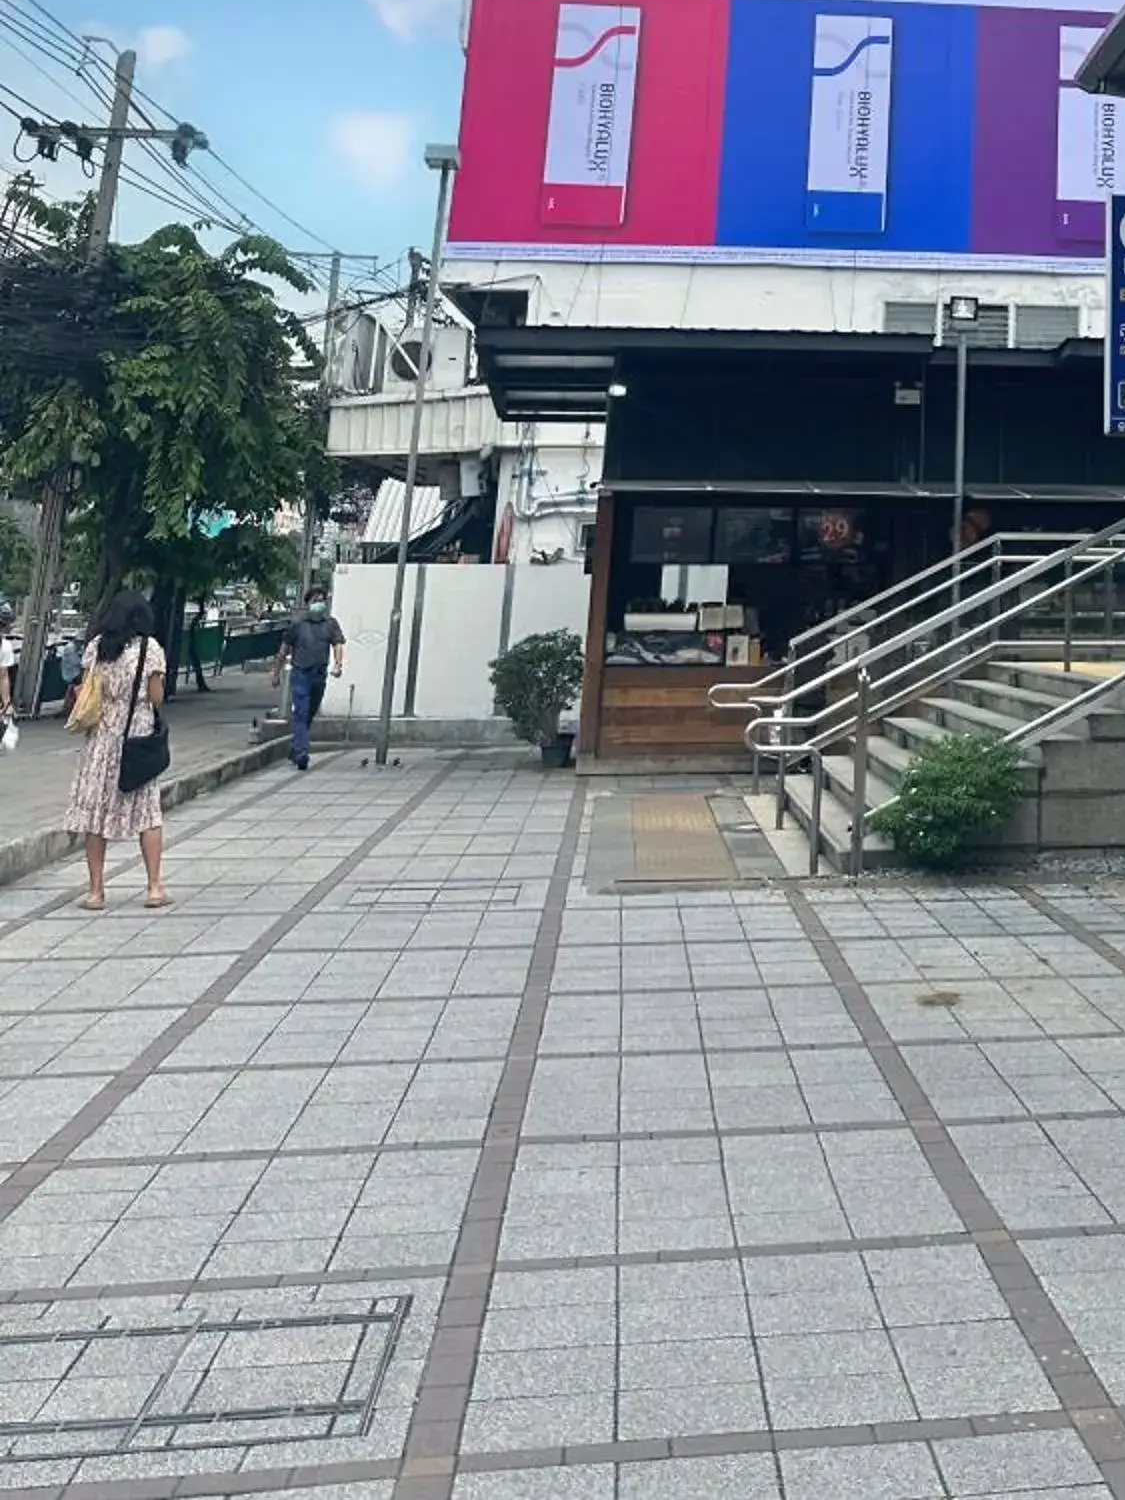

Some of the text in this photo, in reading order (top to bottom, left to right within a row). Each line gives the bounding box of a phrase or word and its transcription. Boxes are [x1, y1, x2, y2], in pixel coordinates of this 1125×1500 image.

[588, 83, 615, 172] BIOHYALUX
[849, 91, 872, 179] BIOHYALUX
[1096, 103, 1116, 189] BIOHYALUX
